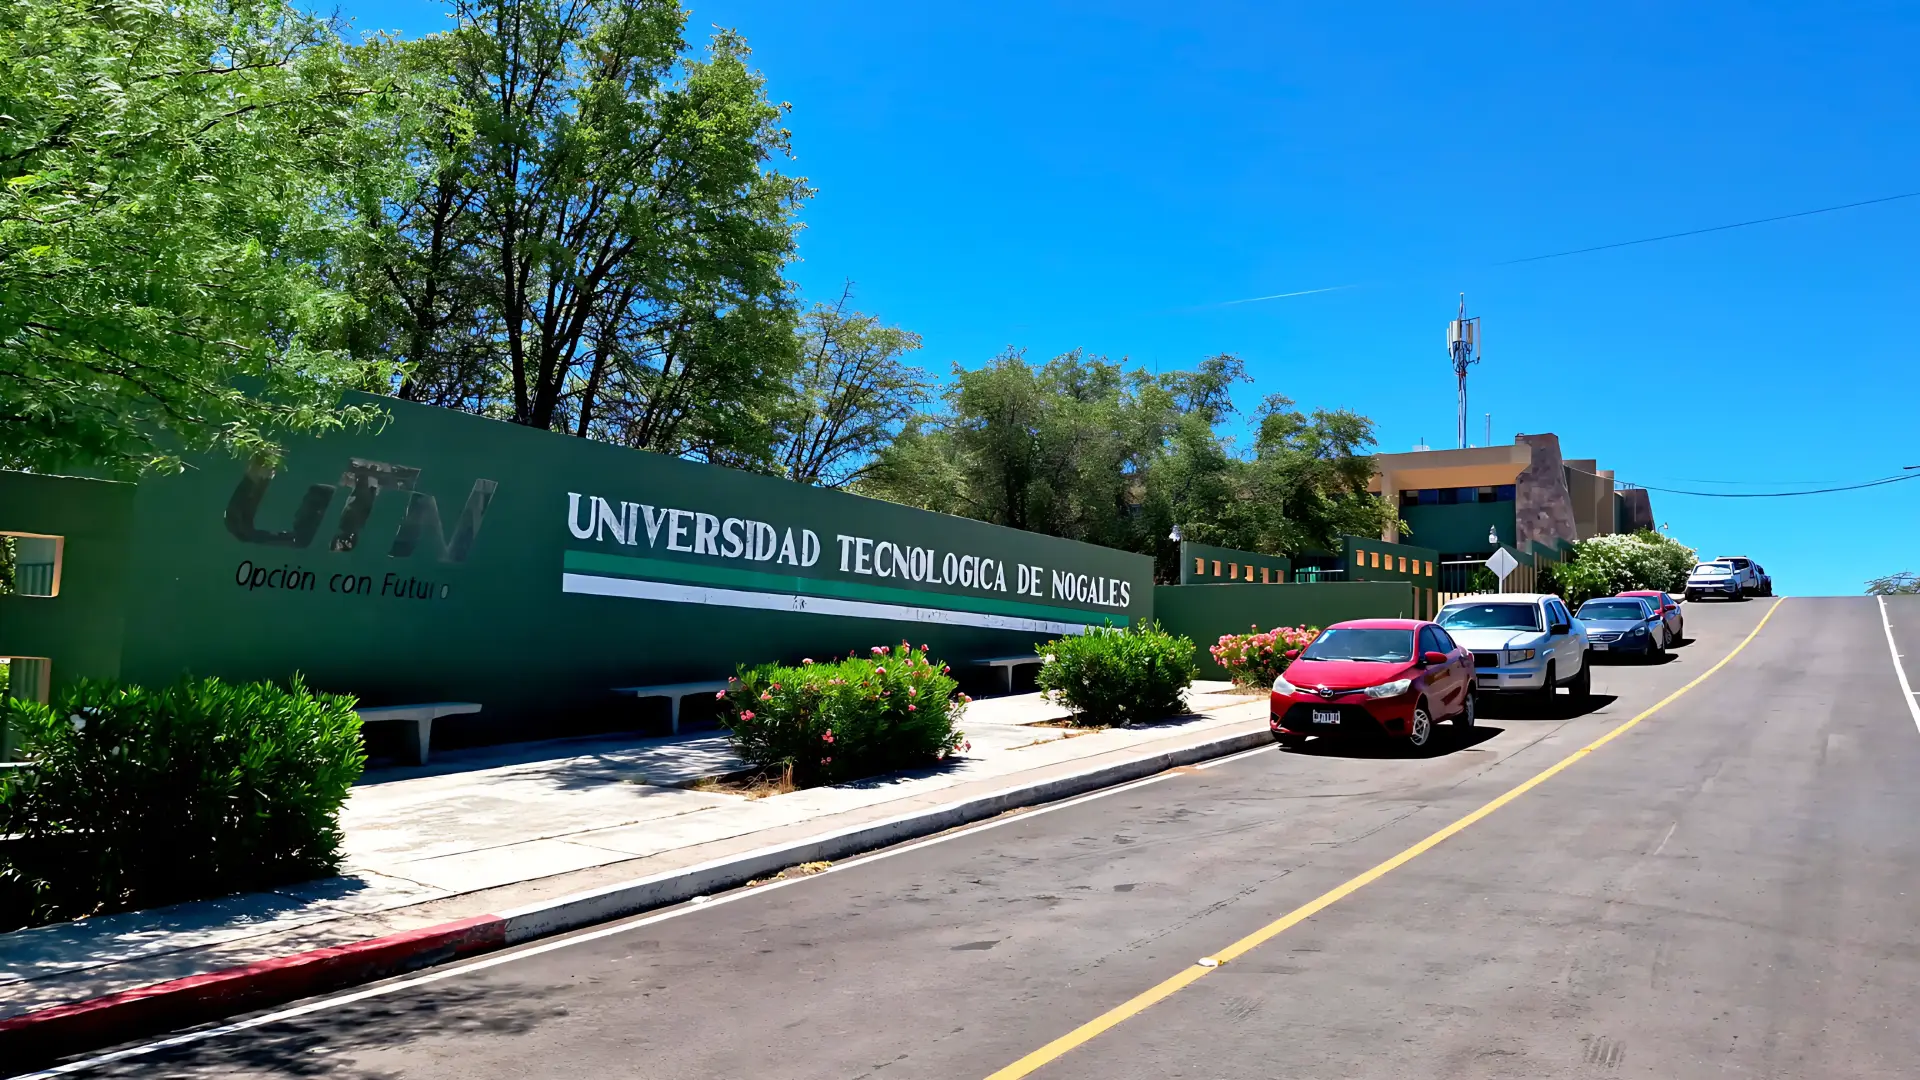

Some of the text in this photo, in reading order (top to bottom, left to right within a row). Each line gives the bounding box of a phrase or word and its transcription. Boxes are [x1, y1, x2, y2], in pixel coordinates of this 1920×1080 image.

[224, 456, 498, 563] UTN
[567, 491, 1131, 608] UNIVERSIDAD TECNOLOGICA DE NOGALES
[235, 560, 316, 591] Opción
[329, 573, 372, 596] con
